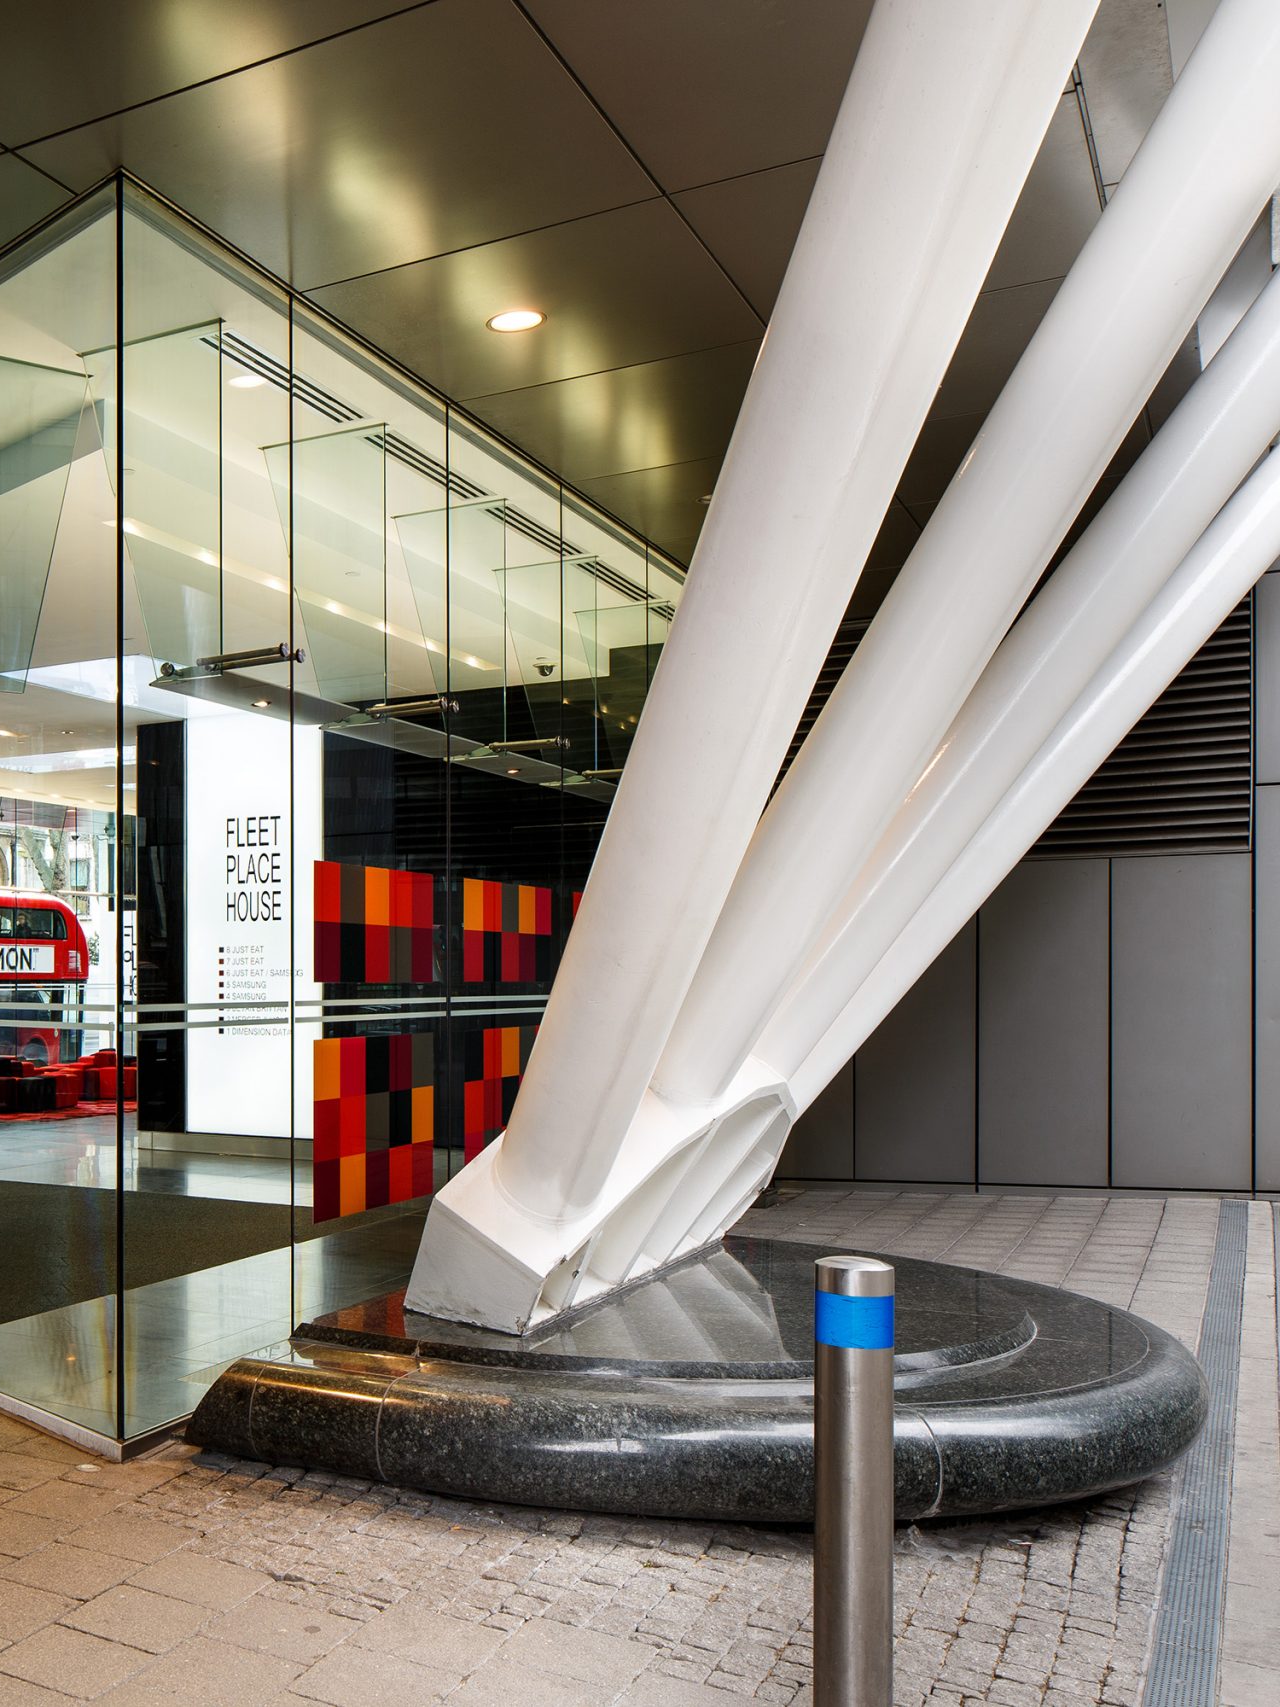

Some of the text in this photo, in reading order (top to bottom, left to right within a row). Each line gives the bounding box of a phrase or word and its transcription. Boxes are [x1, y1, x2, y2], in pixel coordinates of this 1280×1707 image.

[226, 816, 281, 848] FLEET
[226, 853, 281, 884] PLACE
[226, 891, 282, 922] HOUSE
[232, 945, 248, 953] JUST
[250, 945, 264, 953] EAT
[226, 957, 264, 965] 7 JUST EAT
[232, 969, 248, 977] JUST
[250, 969, 264, 977] EAT
[269, 969, 304, 977] SAMSNG
[226, 981, 267, 989] 5 SAMSUNG
[226, 992, 267, 1001] 4 SAMSUNG
[232, 1027, 271, 1036] DIMENSION
